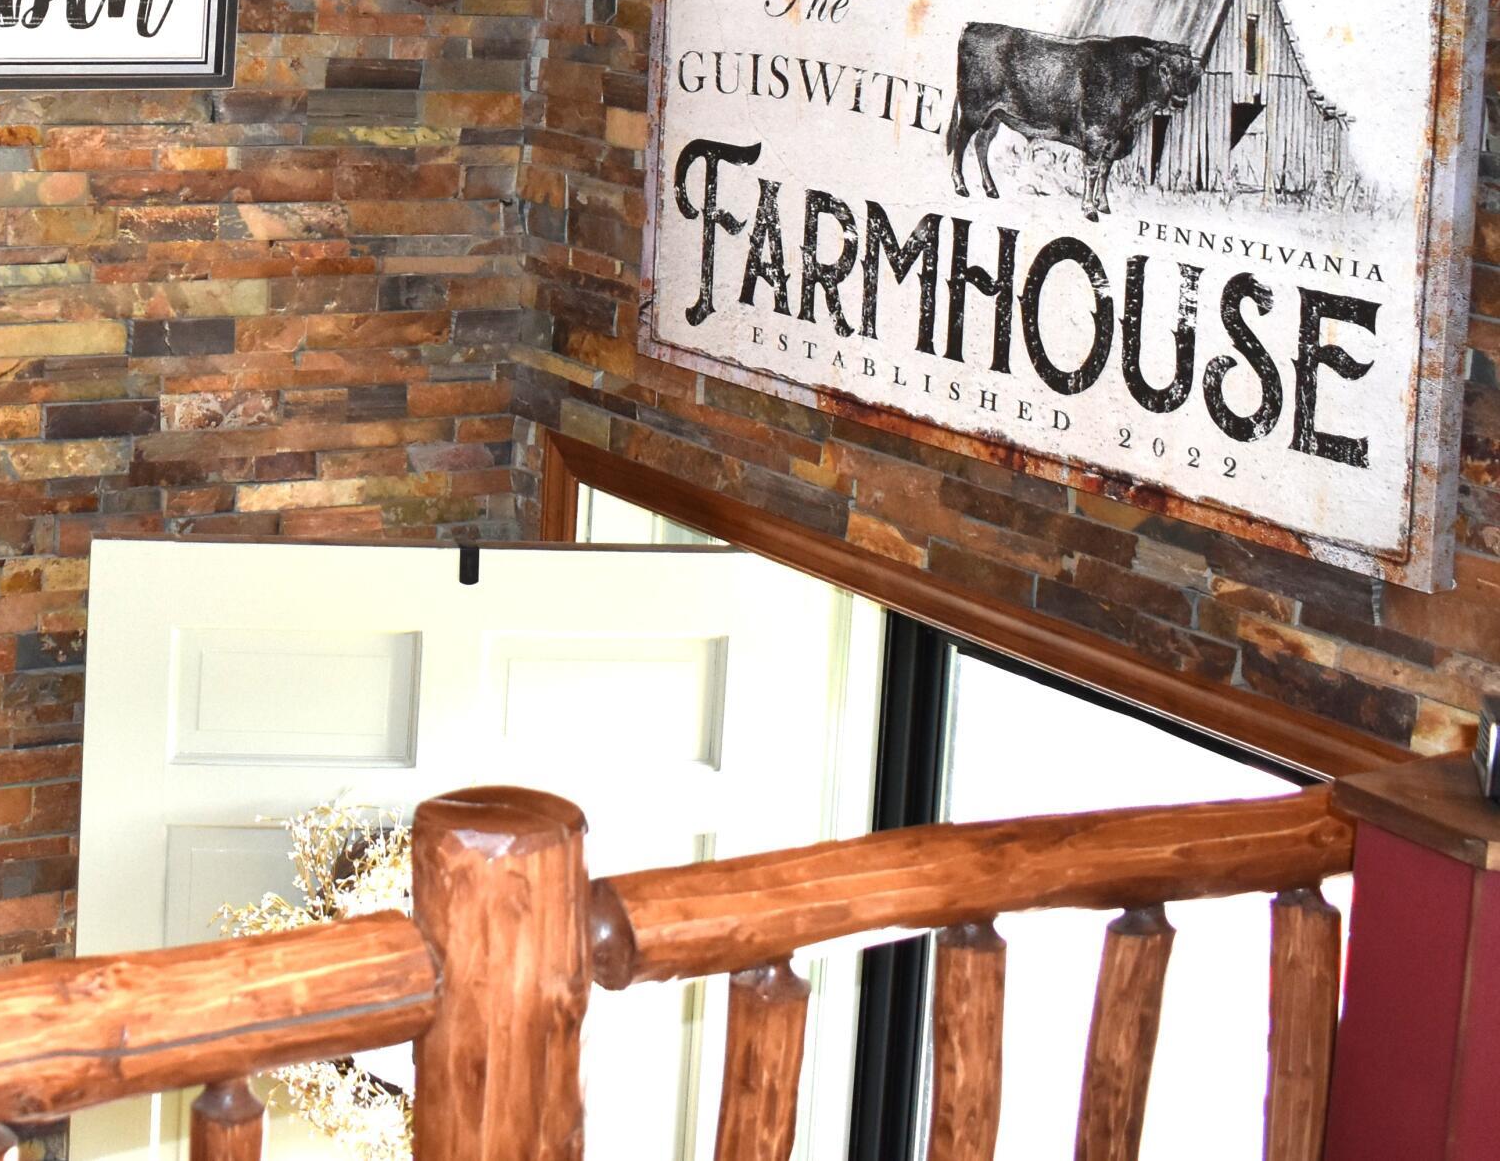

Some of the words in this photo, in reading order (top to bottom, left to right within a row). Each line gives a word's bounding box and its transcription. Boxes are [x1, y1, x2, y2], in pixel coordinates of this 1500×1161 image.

[677, 51, 943, 136] GUISWITE
[673, 138, 1383, 469] FARMHOUSE
[1137, 219, 1384, 283] PENNSYLVANIA
[751, 325, 1073, 433] ESTABLISHED
[1117, 426, 1240, 479] 2022
